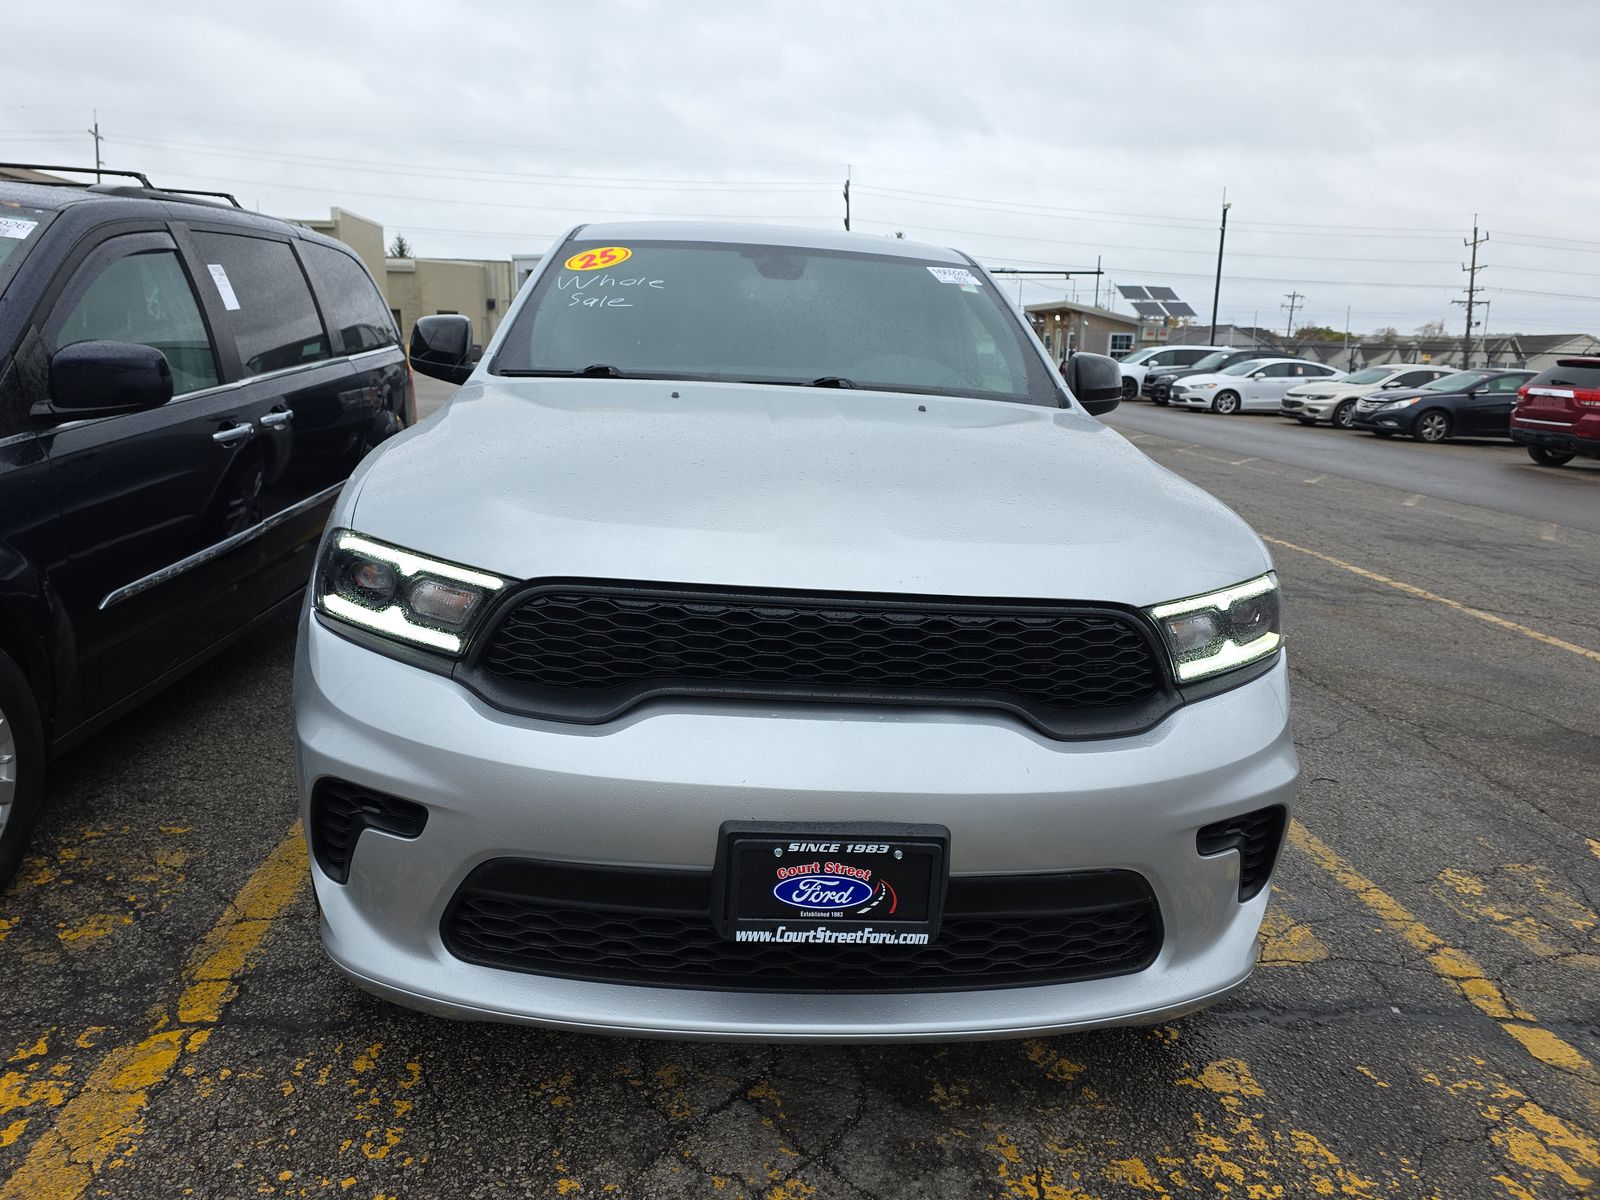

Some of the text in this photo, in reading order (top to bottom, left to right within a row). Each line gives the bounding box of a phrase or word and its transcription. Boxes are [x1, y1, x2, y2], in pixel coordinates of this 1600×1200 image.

[579, 248, 617, 269] 25
[558, 274, 664, 289] Whole
[788, 843, 890, 854] SINCE 1983
[776, 862, 871, 881] Court Street
[792, 879, 854, 904] Ford
[800, 910, 830, 918] Established
